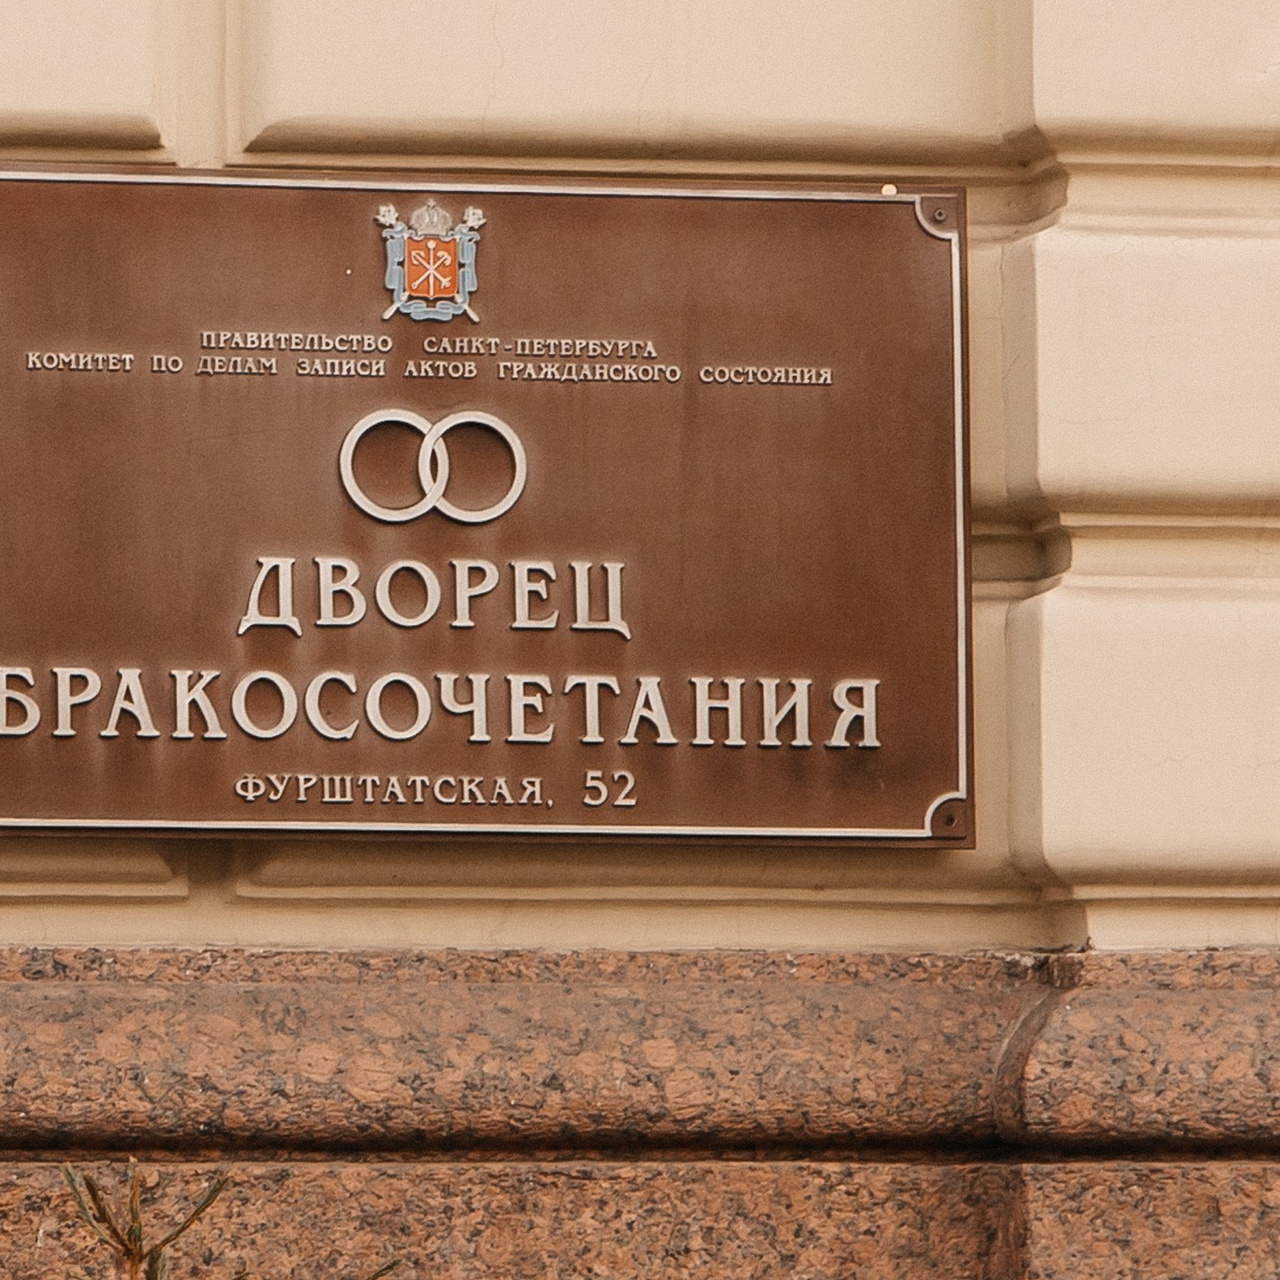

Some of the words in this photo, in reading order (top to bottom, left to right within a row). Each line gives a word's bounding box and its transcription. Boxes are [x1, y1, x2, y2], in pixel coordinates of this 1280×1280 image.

[200, 330, 393, 352] ПРАВИТЕЛЬСТВО
[423, 336, 658, 358] САНКТ-ПЕТЕРБУРГА
[26, 352, 135, 371] КОМИТЕТ
[151, 354, 183, 372] ПО
[196, 356, 278, 375] ДЕЛАМ
[296, 358, 386, 377] ЗАПИСИ
[403, 360, 478, 378] АКТОВ
[497, 361, 682, 383] ГРАЖДАНСКОГО
[699, 366, 833, 385] СОСТОЯНИЯ
[237, 556, 632, 640] ДВОРЕЦ
[234, 773, 555, 808] ФУРШТАТСКАЯ,
[582, 769, 638, 807] 52
